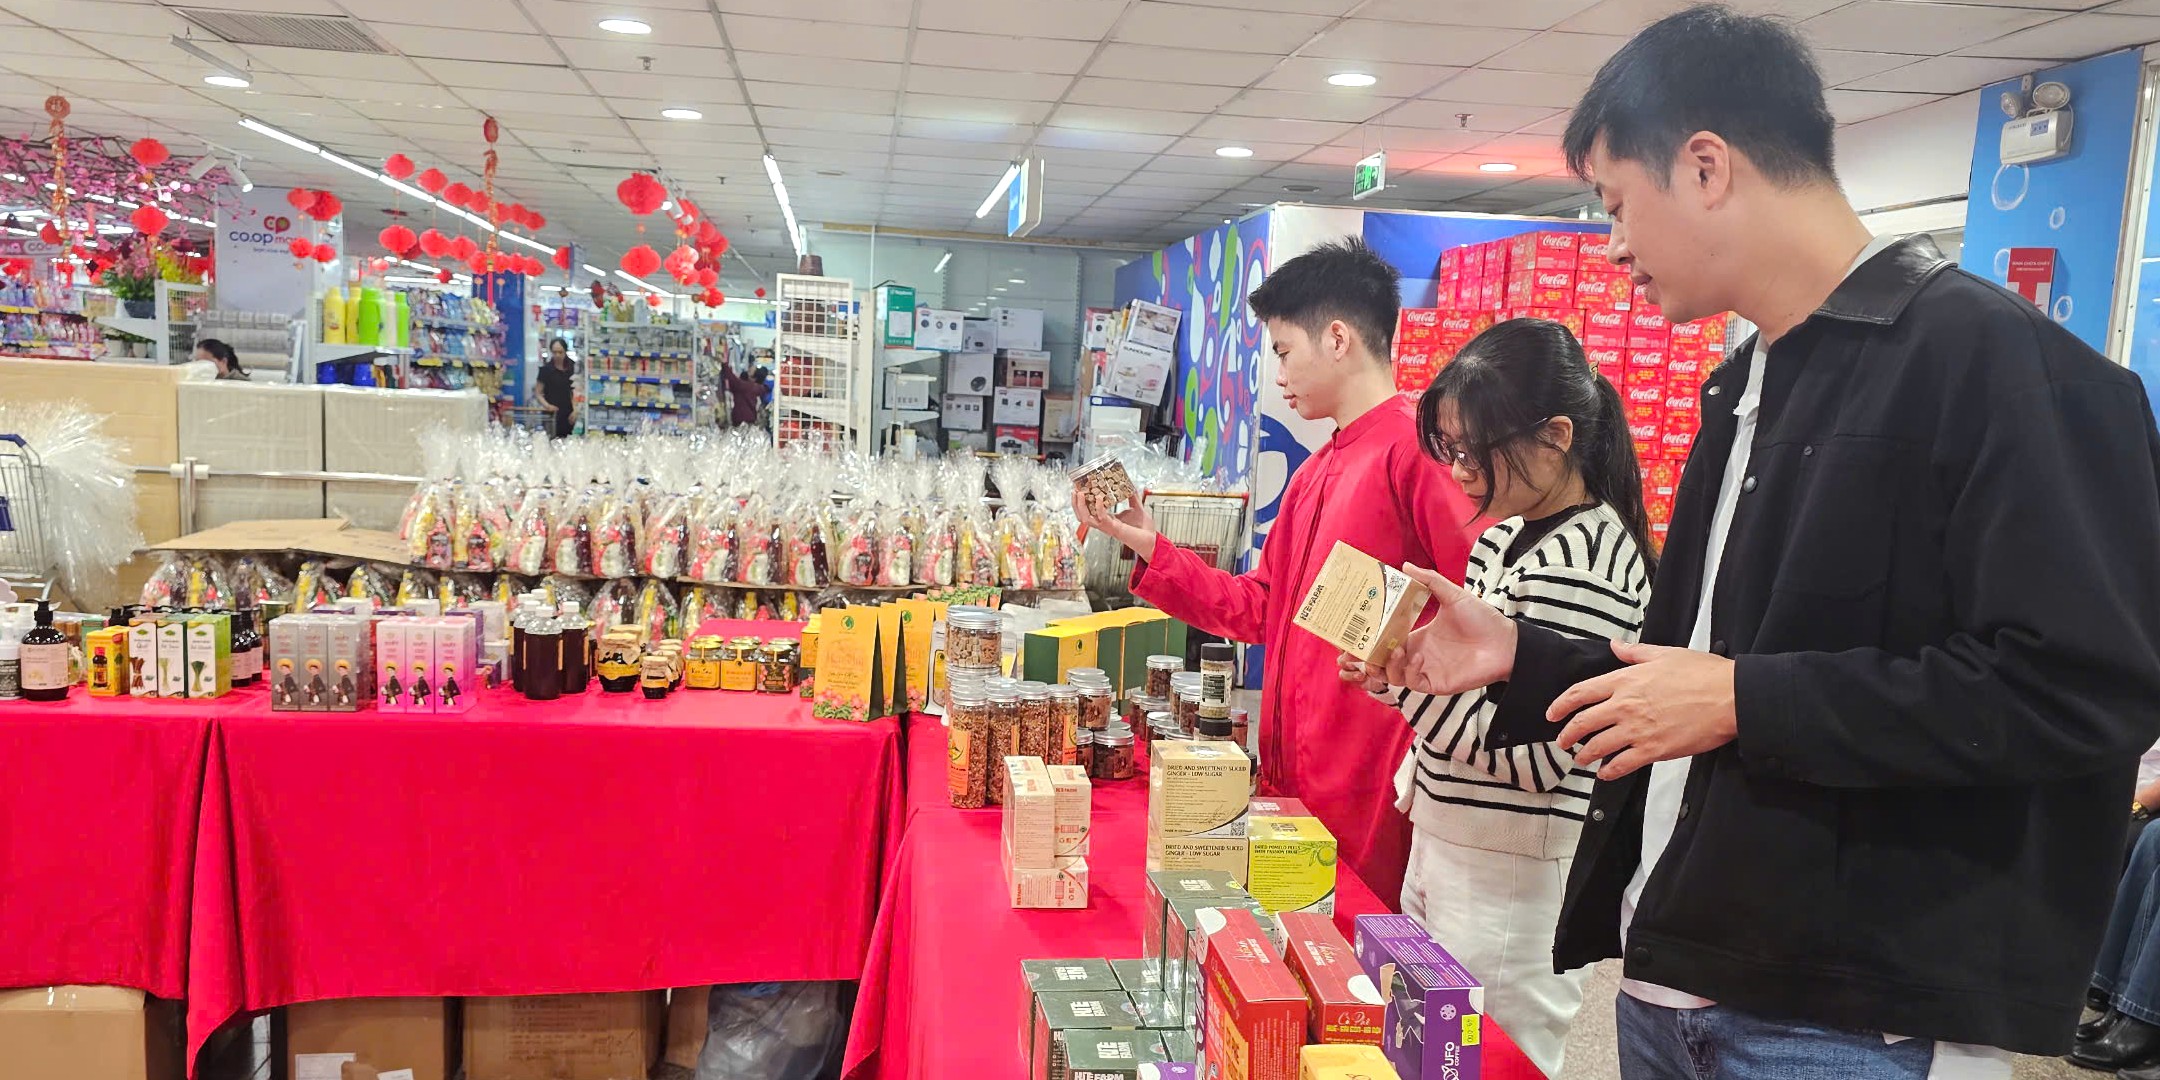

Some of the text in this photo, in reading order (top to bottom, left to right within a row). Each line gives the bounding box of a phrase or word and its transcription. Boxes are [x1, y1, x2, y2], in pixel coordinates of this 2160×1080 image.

[1542, 235, 1573, 248] Coca-Cola
[1539, 273, 1568, 286] Coca-Cola
[1577, 281, 1606, 294] Coca-Cola
[1442, 319, 1471, 330] Coca-Cola
[1591, 312, 1622, 325] Coca-Cola
[1635, 315, 1664, 328] Coca-Cola
[1671, 323, 1701, 336] Coca-Cola
[1632, 352, 1663, 364] Coca-Cola
[1668, 360, 1698, 372] Coca-Cola
[1630, 388, 1660, 400] Coca-Cola
[1666, 396, 1695, 409] Coca-Cola
[1662, 433, 1692, 444] Coca-Cola
[1445, 1041, 1455, 1066] UFO
